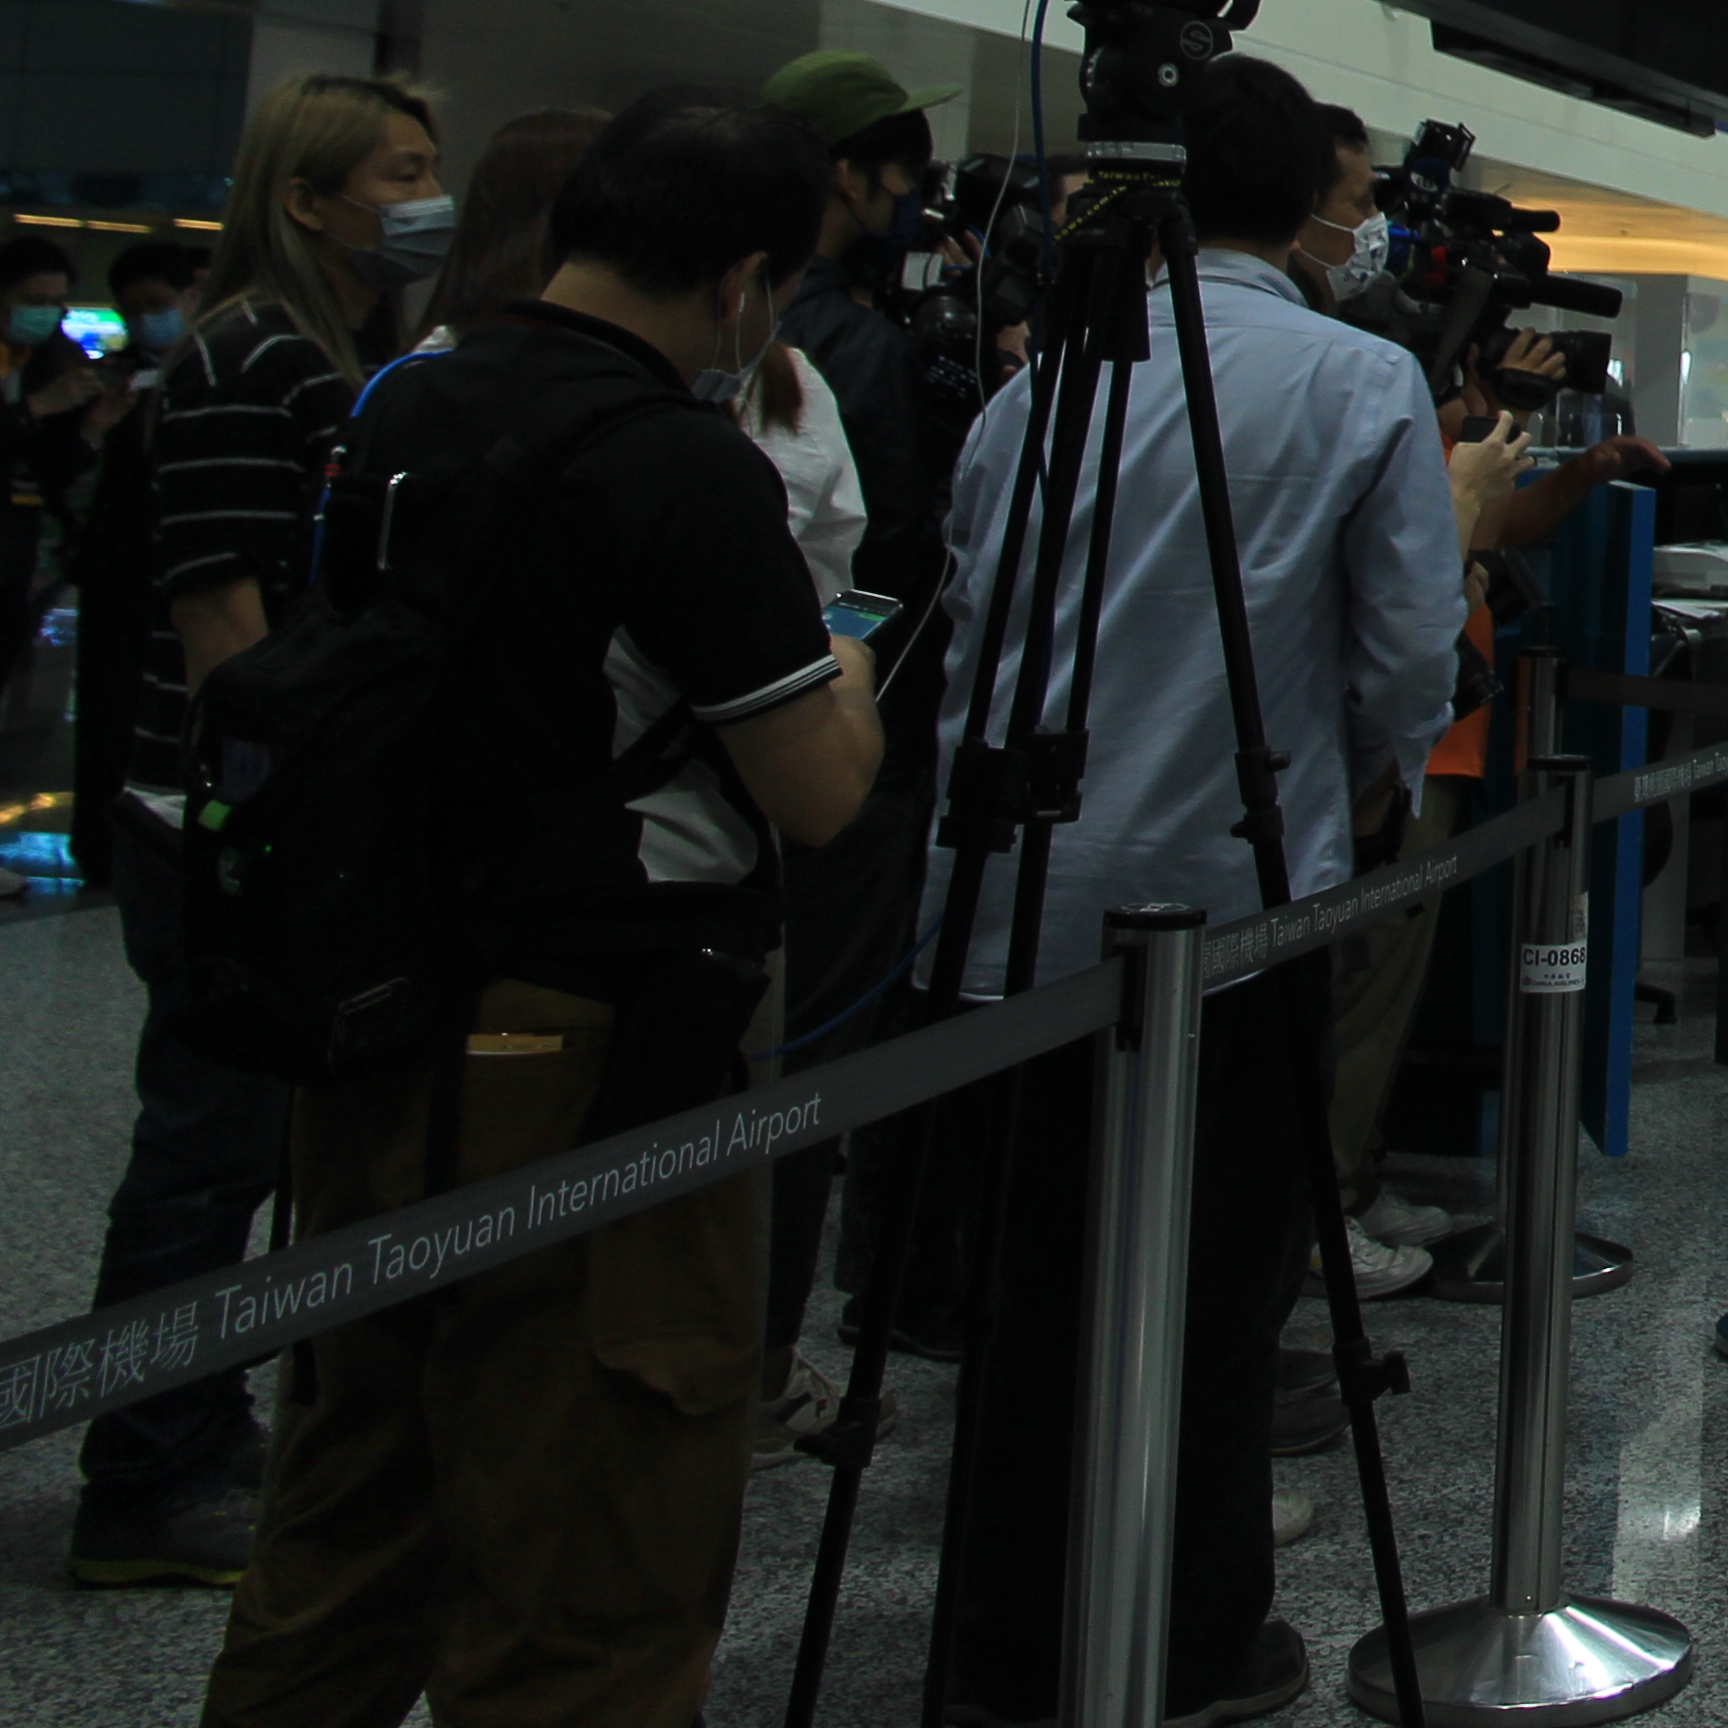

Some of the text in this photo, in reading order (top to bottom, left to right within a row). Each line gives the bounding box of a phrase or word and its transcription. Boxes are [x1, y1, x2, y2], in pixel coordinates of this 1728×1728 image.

[1270, 915, 1311, 949] Taiwan
[1312, 898, 1360, 935] Taoyuan
[1361, 868, 1424, 912] International
[1424, 853, 1459, 889] Airport
[1523, 946, 1586, 967] CI-0868
[214, 1264, 353, 1342] Taiwan
[368, 1206, 516, 1280] Taoyuan
[527, 1119, 723, 1229] International
[725, 1090, 823, 1157] Airport
